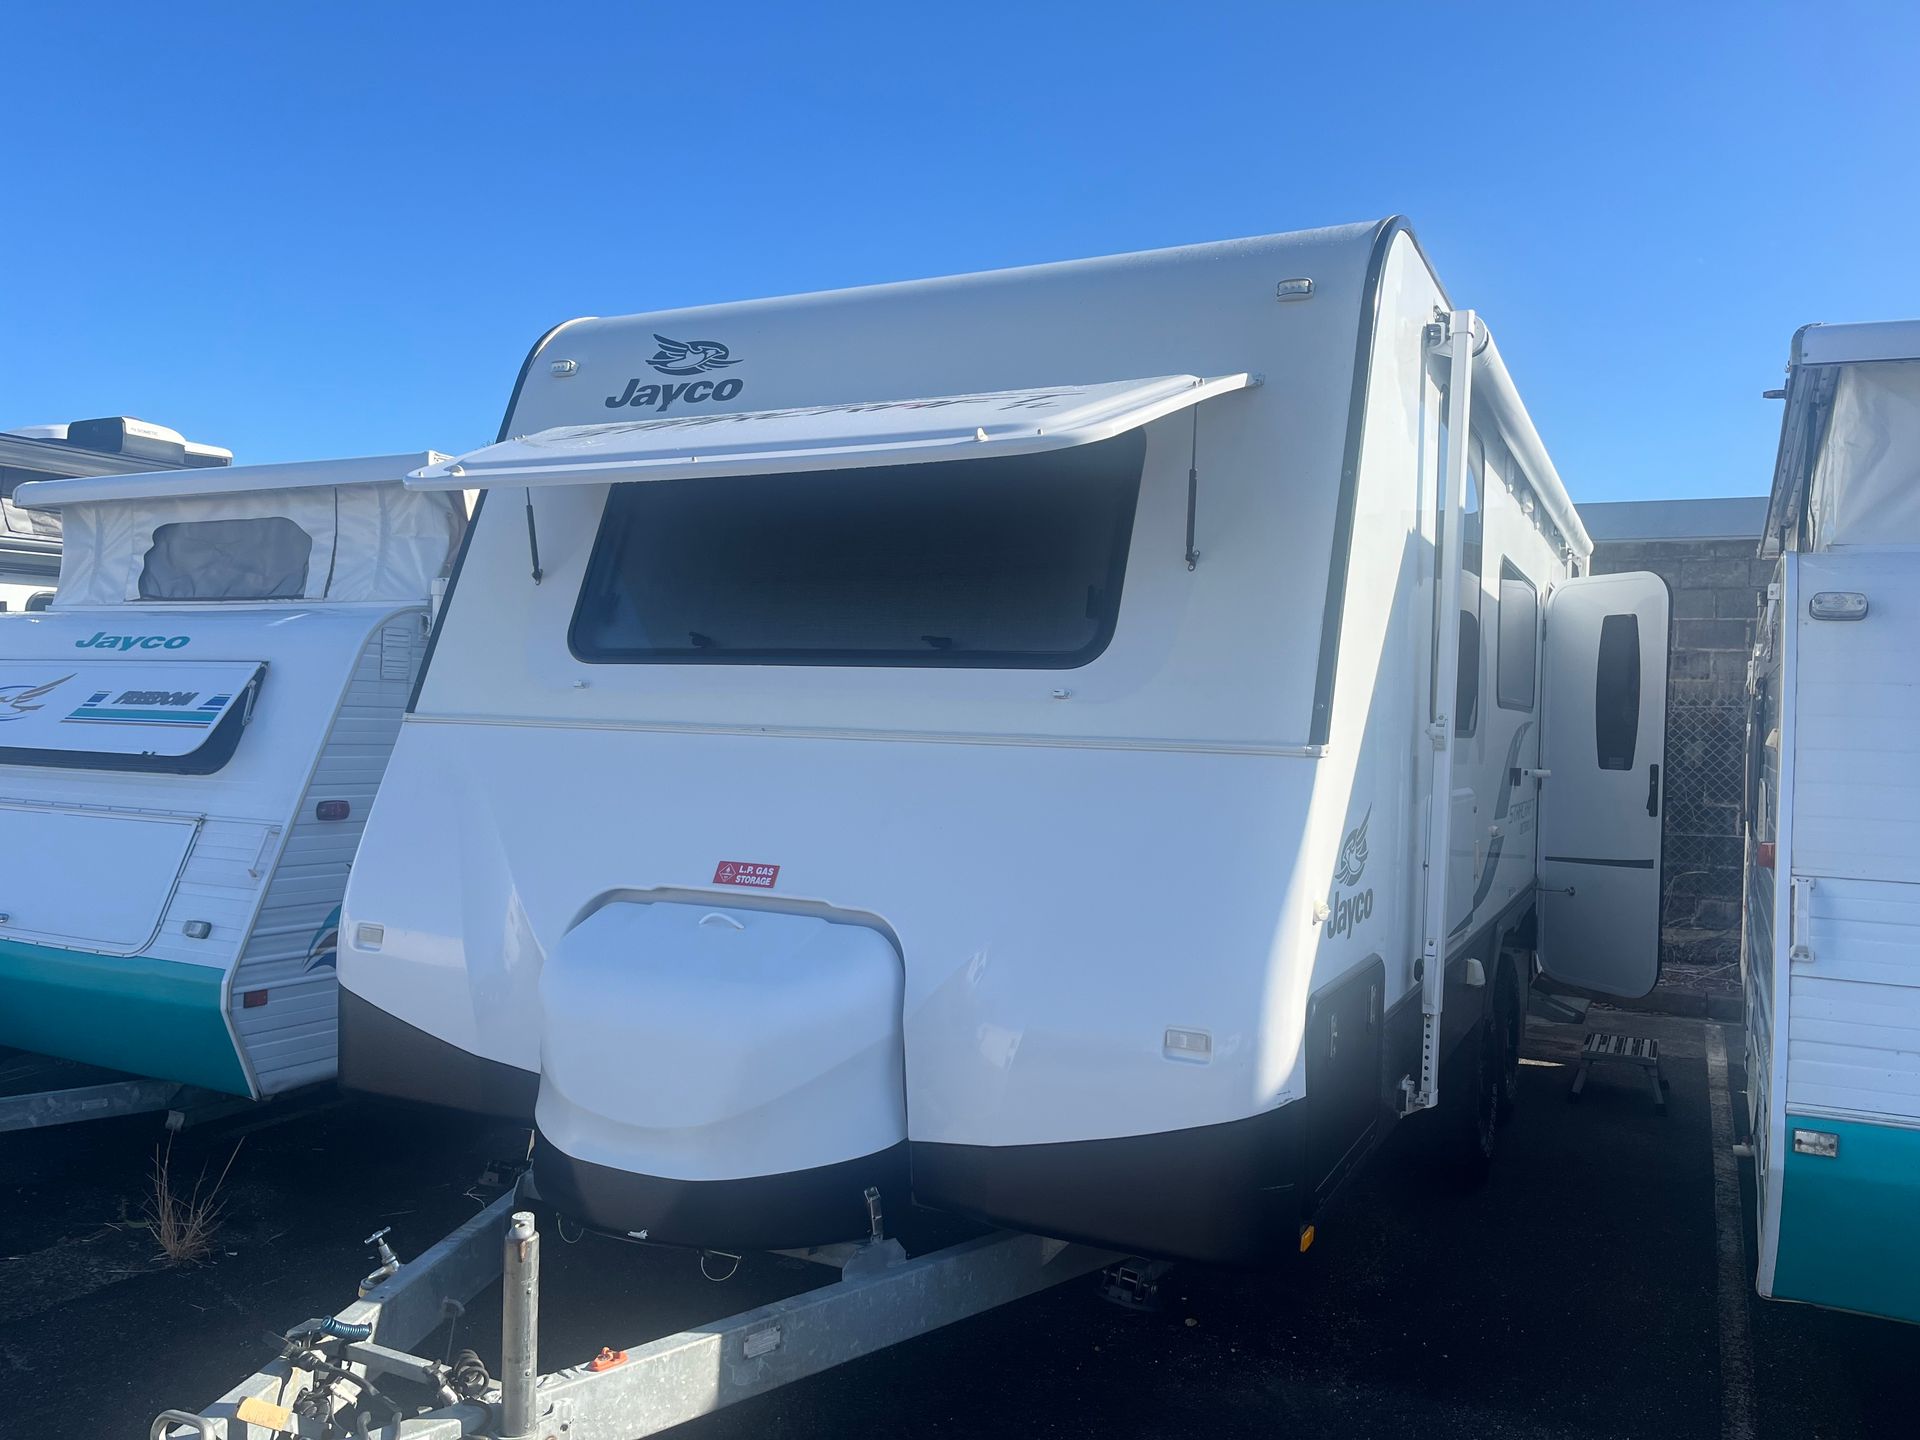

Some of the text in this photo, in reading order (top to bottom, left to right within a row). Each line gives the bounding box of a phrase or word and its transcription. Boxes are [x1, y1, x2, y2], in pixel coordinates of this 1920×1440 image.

[605, 378, 744, 412] Jayco
[75, 632, 191, 651] Jayco
[111, 691, 200, 706] FREEDOM
[756, 867, 774, 876] GAS
[735, 875, 771, 886] STORAGE
[1327, 888, 1373, 940] Jayco
